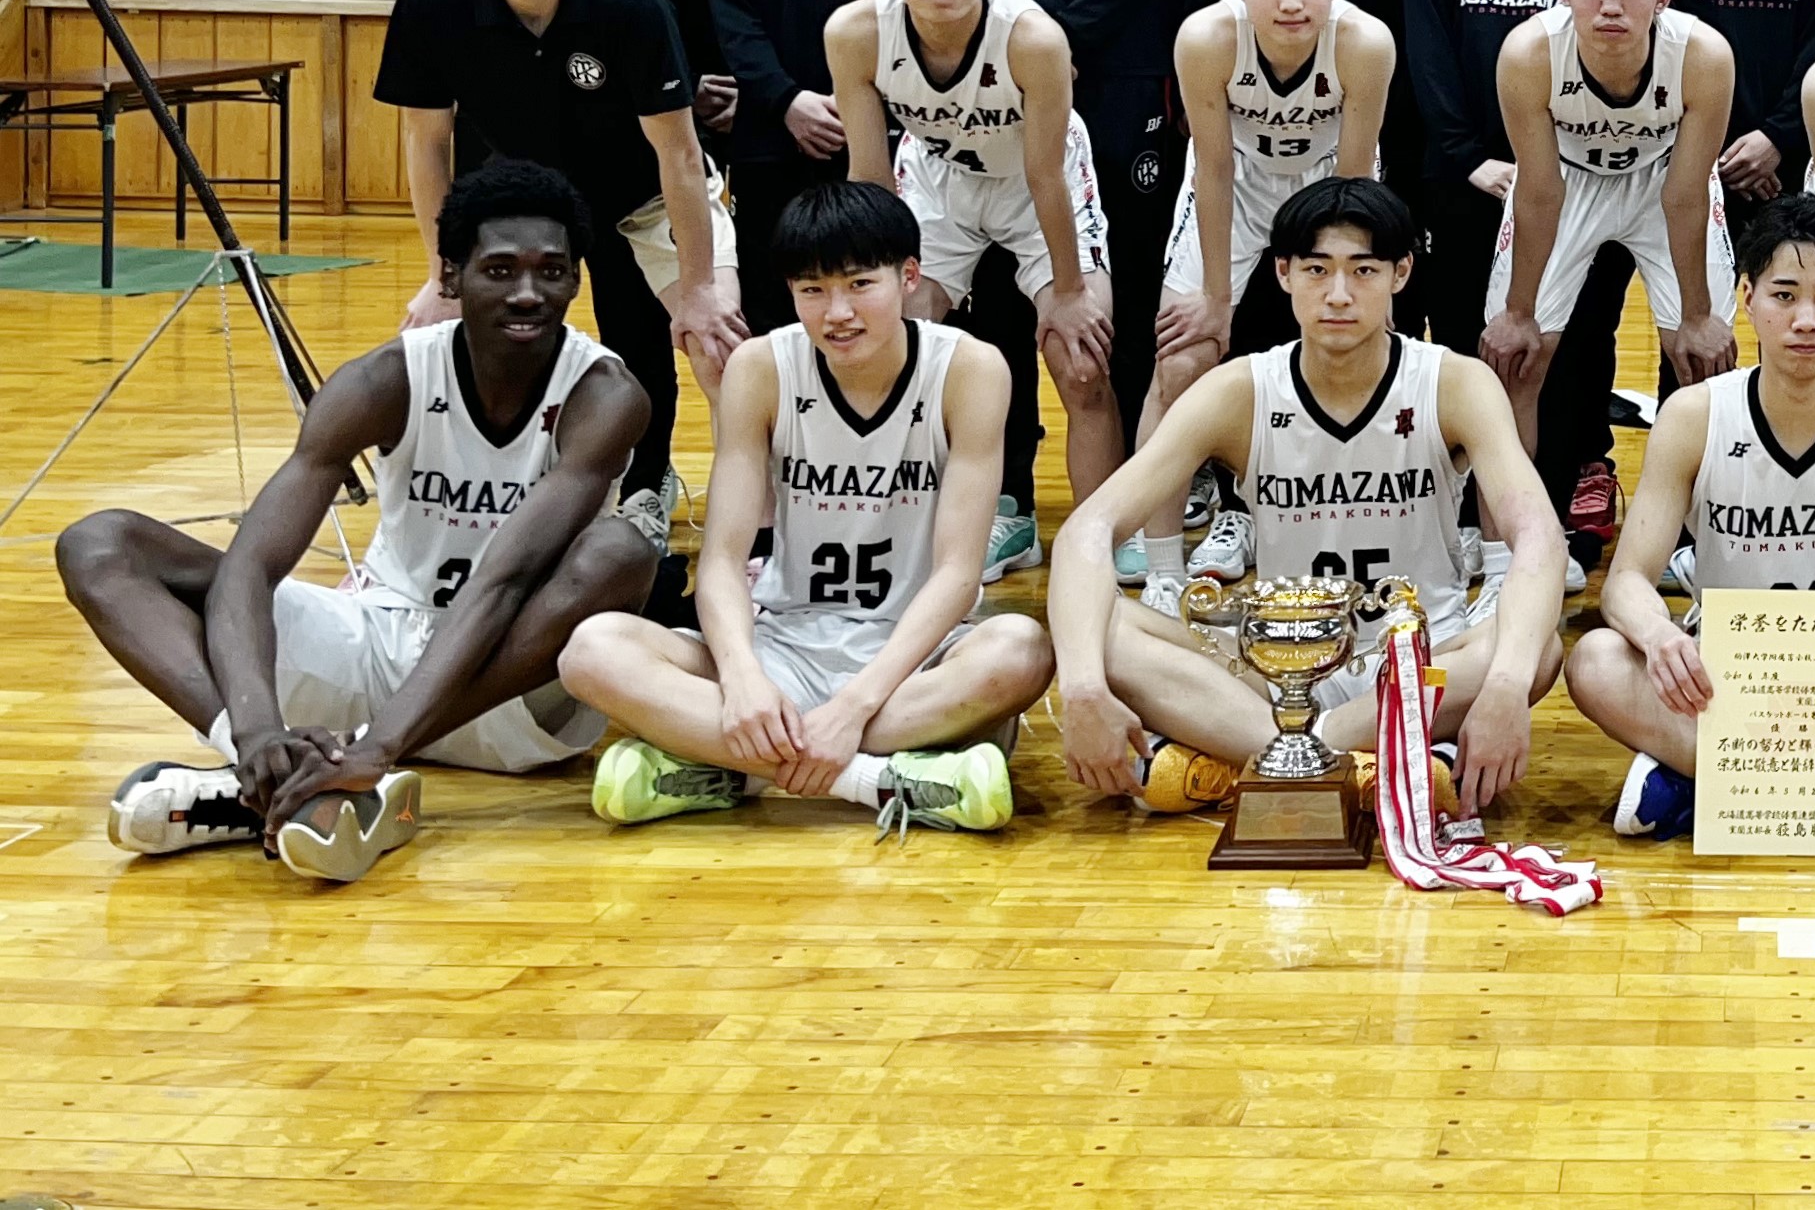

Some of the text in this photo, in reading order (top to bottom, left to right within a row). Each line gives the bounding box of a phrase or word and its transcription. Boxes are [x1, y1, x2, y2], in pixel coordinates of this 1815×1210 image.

[1256, 134, 1311, 158] 13
[1270, 411, 1296, 429] BF
[1256, 468, 1436, 509] KOMAZAWA
[1277, 503, 1415, 523] TOMAKOMAI
[809, 537, 893, 610] 25
